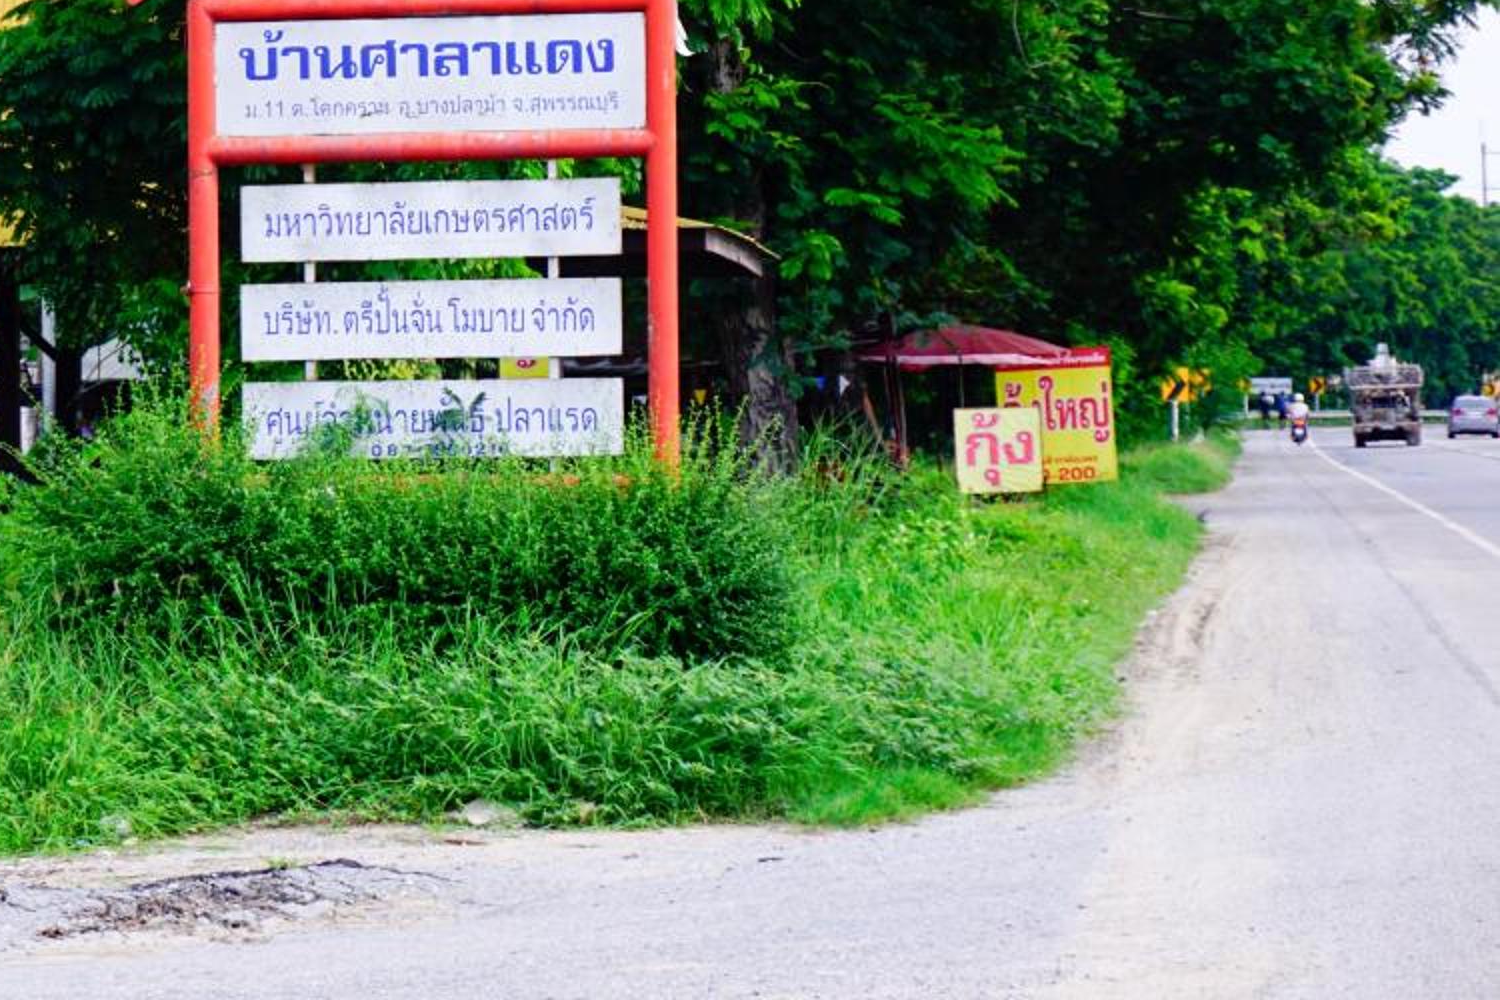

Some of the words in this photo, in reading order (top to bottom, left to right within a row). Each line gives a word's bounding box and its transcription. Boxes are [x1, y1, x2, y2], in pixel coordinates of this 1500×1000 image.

[238, 29, 615, 81] บ้านศาลาแดง
[264, 196, 596, 238] มหาวิทยาลัยเกษตรศาสตร์
[965, 412, 1034, 486] กุ้ง
